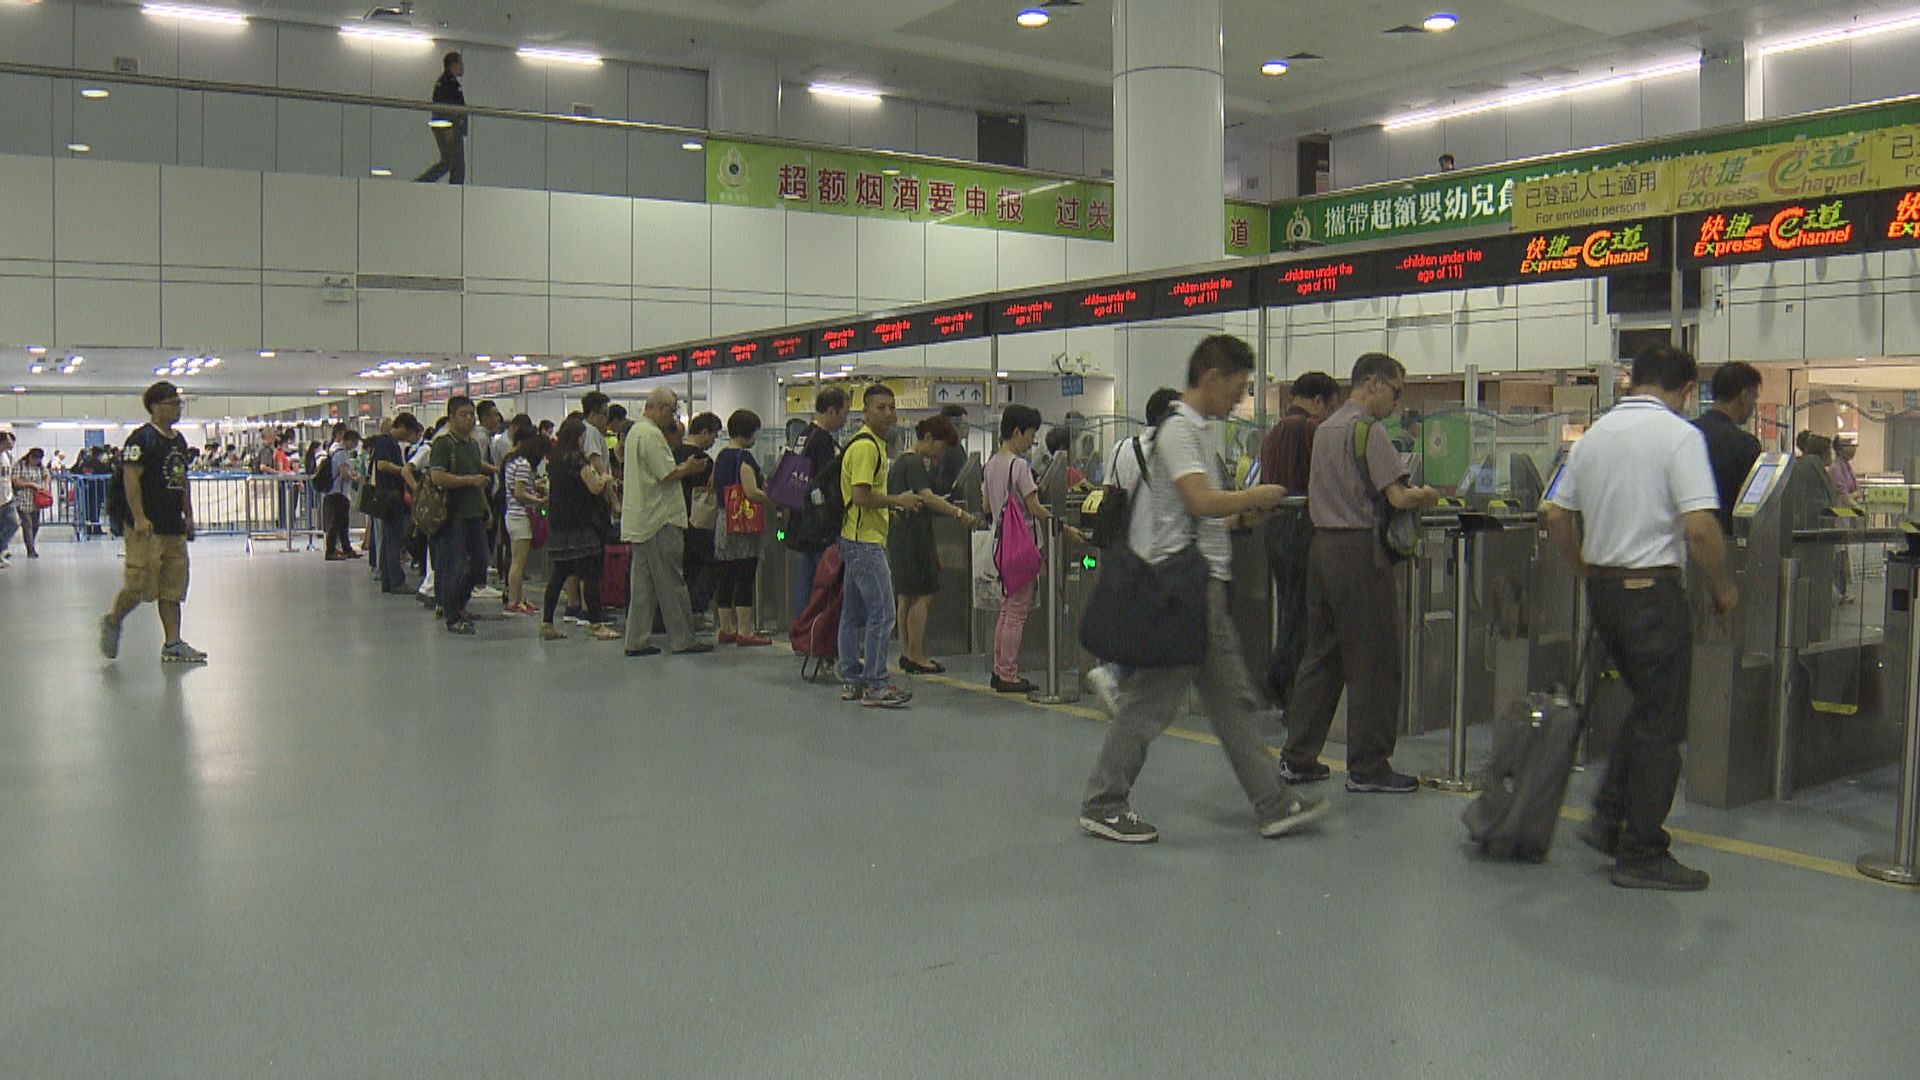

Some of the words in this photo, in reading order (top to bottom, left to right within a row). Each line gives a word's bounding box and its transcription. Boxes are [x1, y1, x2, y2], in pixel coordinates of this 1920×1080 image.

[1892, 134, 1920, 160] 已
[1688, 155, 1747, 190] 快捷
[1525, 169, 1657, 209] 已登記人士適用
[1677, 186, 1760, 209] Express
[777, 163, 1024, 222] 超额烟酒要申报
[1056, 194, 1110, 231] 过关
[1230, 216, 1250, 248] 道
[1535, 211, 1553, 224] For
[1556, 205, 1599, 222] enrolled
[1602, 201, 1647, 220] persons
[1693, 238, 1763, 257] Express
[1769, 207, 1852, 249] Channel
[1701, 212, 1754, 241] 快捷
[1439, 250, 1464, 265] under
[1466, 248, 1482, 262] the
[1520, 257, 1578, 274] Express
[1583, 230, 1649, 268] Channel
[1526, 235, 1570, 260] 快捷
